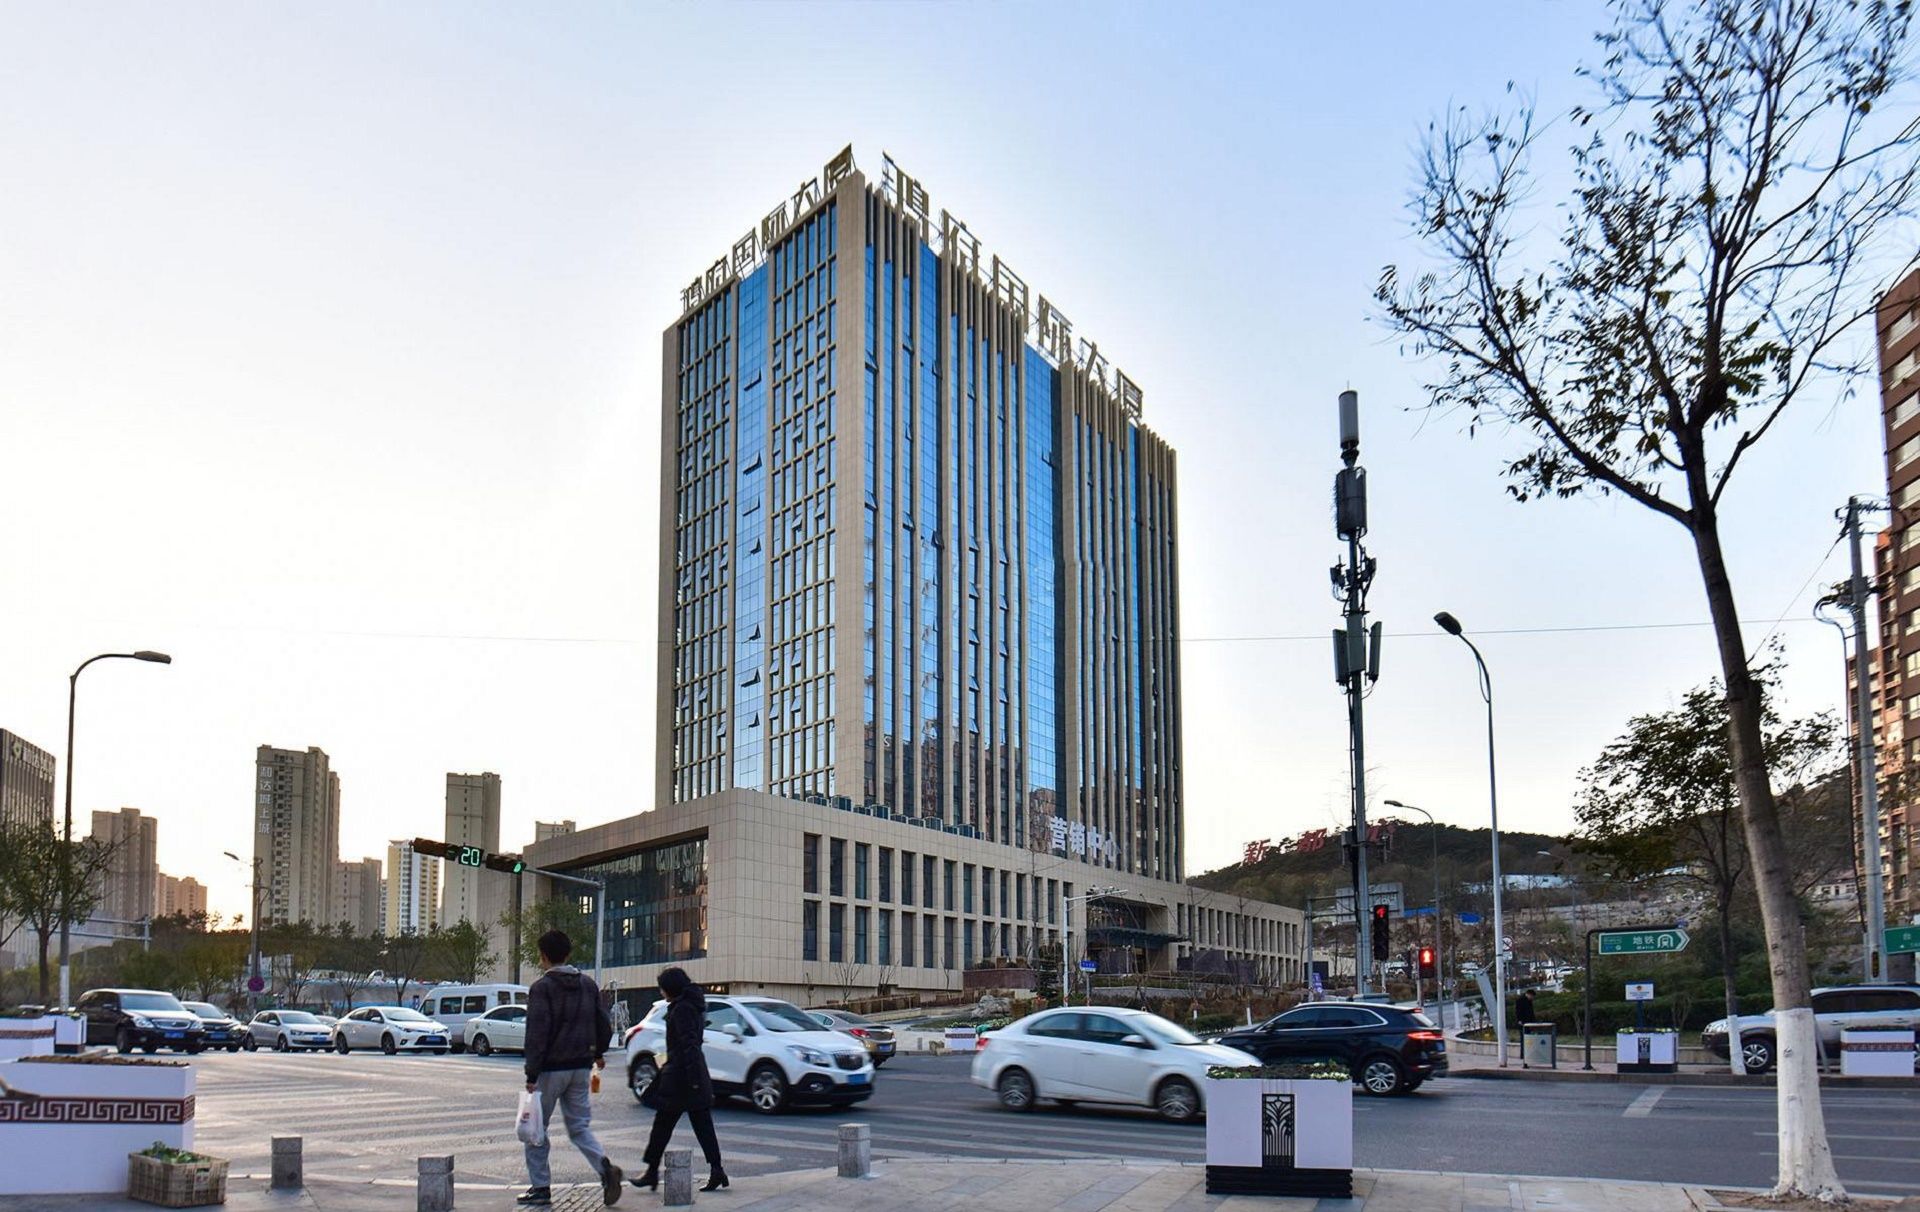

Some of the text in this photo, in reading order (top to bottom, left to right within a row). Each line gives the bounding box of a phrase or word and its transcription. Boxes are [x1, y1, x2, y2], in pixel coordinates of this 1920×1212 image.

[1050, 815, 1120, 862] 营销中心
[461, 846, 480, 866] 20
